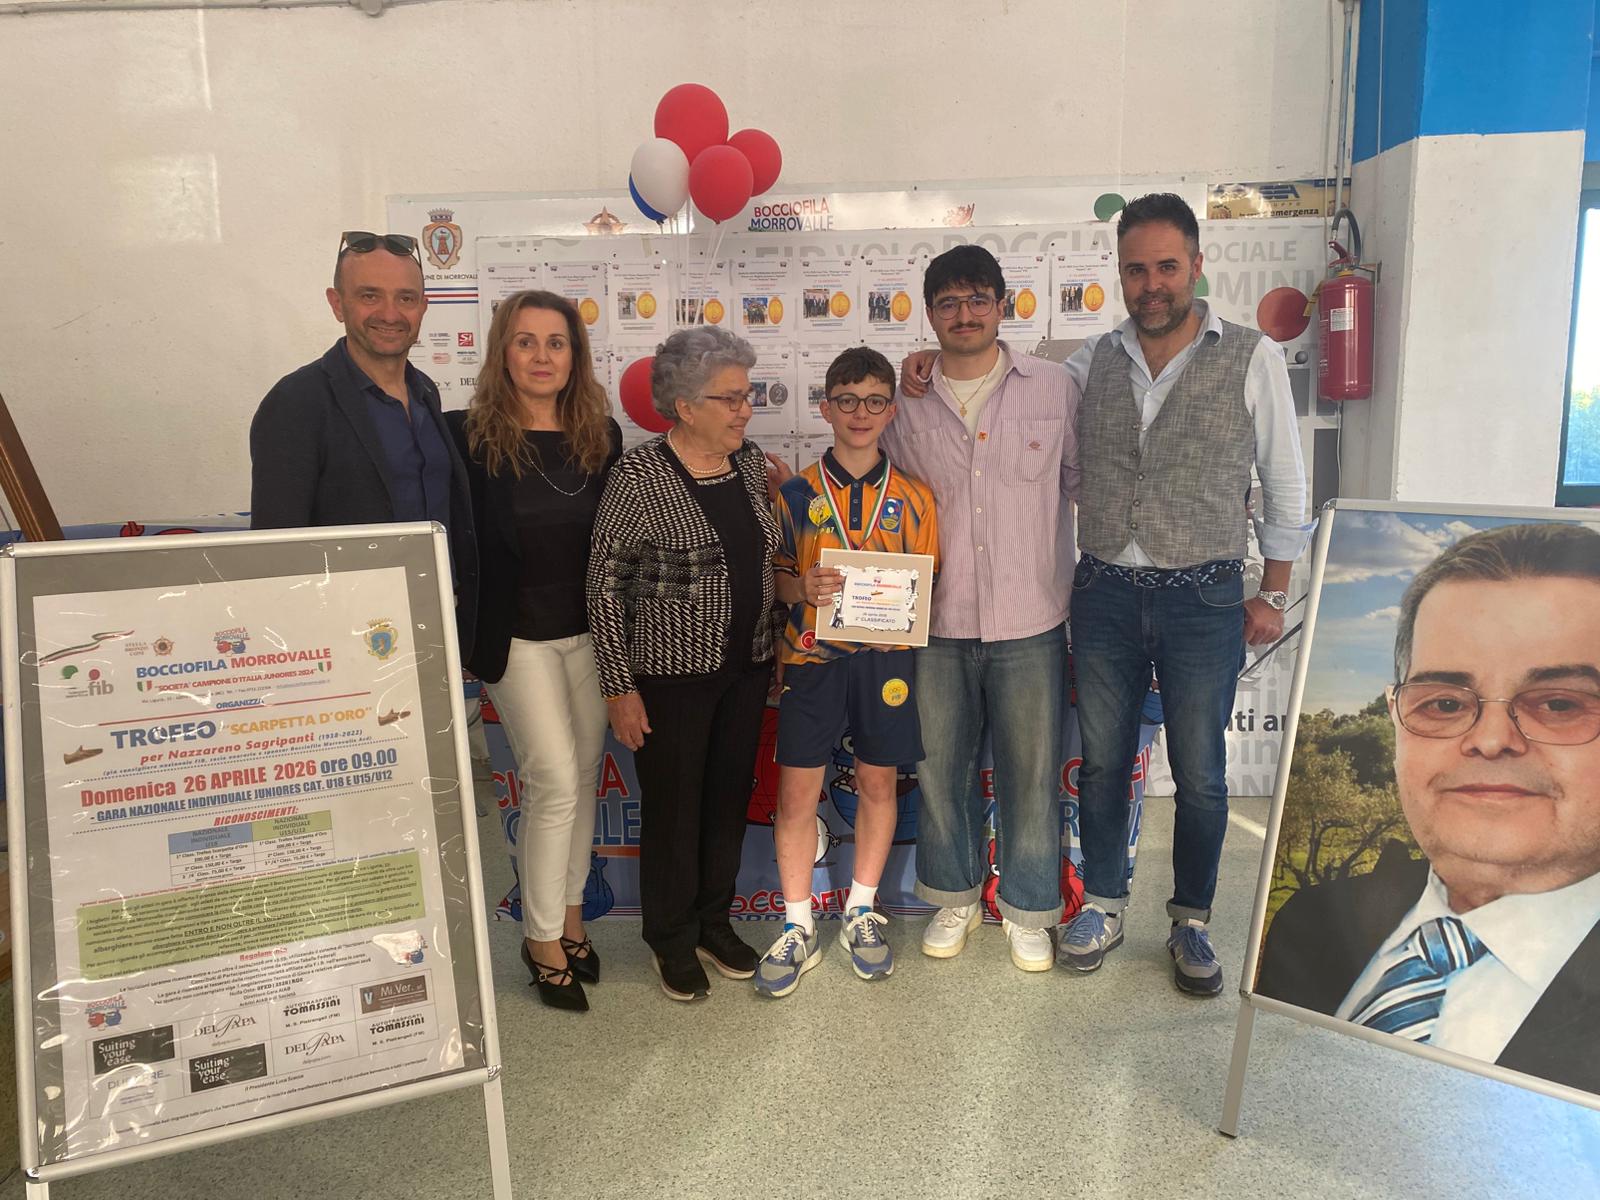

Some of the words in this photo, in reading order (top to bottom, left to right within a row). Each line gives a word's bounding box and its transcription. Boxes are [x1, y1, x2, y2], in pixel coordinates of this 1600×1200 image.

[754, 197, 830, 217] BOCCIOFILA
[750, 215, 833, 231] MORROVALLE
[1204, 241, 1297, 263] OCIALE
[136, 659, 227, 677] BOCCIOFILA
[230, 648, 331, 667] MORROVALLE
[87, 679, 114, 695] fib
[191, 677, 230, 687] CAMPIONE
[232, 674, 262, 683] D'ITALIA
[263, 670, 297, 679] JUNIORES
[110, 720, 216, 749] TROFEO
[139, 753, 163, 764] per
[167, 743, 240, 759] Nazzareno
[245, 733, 314, 750] Sagripanti
[80, 778, 176, 806] Domenica
[183, 774, 207, 792] 26
[209, 766, 266, 788] APRILE
[273, 760, 316, 779] 2026
[320, 758, 348, 773] ore
[351, 748, 397, 768] 09.00
[97, 808, 126, 821] GARA
[129, 800, 185, 816] NAZIONALE
[188, 790, 251, 807] INDIVIDUALE
[254, 784, 301, 798] JUNIORES
[303, 780, 324, 791] CAT.
[326, 777, 344, 788] U18
[346, 776, 351, 785] E
[353, 771, 392, 784] U15/U12
[213, 805, 299, 825] RICONOSCIMENTI:
[274, 815, 307, 823] NAZIONALE
[192, 827, 228, 835] NAZIONALE
[272, 820, 310, 830] INDIVIDUALE
[191, 832, 230, 843] INDIVIDUALE
[184, 927, 209, 936] ENTRO
[232, 919, 254, 927] OLTRE
[282, 999, 340, 1016] TOMASSINI
[285, 995, 338, 1008] AUTOTRASPORTI
[369, 1017, 424, 1034] TOMASSINI
[371, 1013, 422, 1026] AUTOTRASPORTI
[98, 1037, 136, 1054] Suiting
[102, 1048, 126, 1060] your
[284, 1043, 306, 1054] DEL
[106, 1054, 134, 1065] ease.
[194, 1055, 229, 1072] Suiting
[198, 1067, 221, 1079] your
[202, 1072, 229, 1083] ease.
